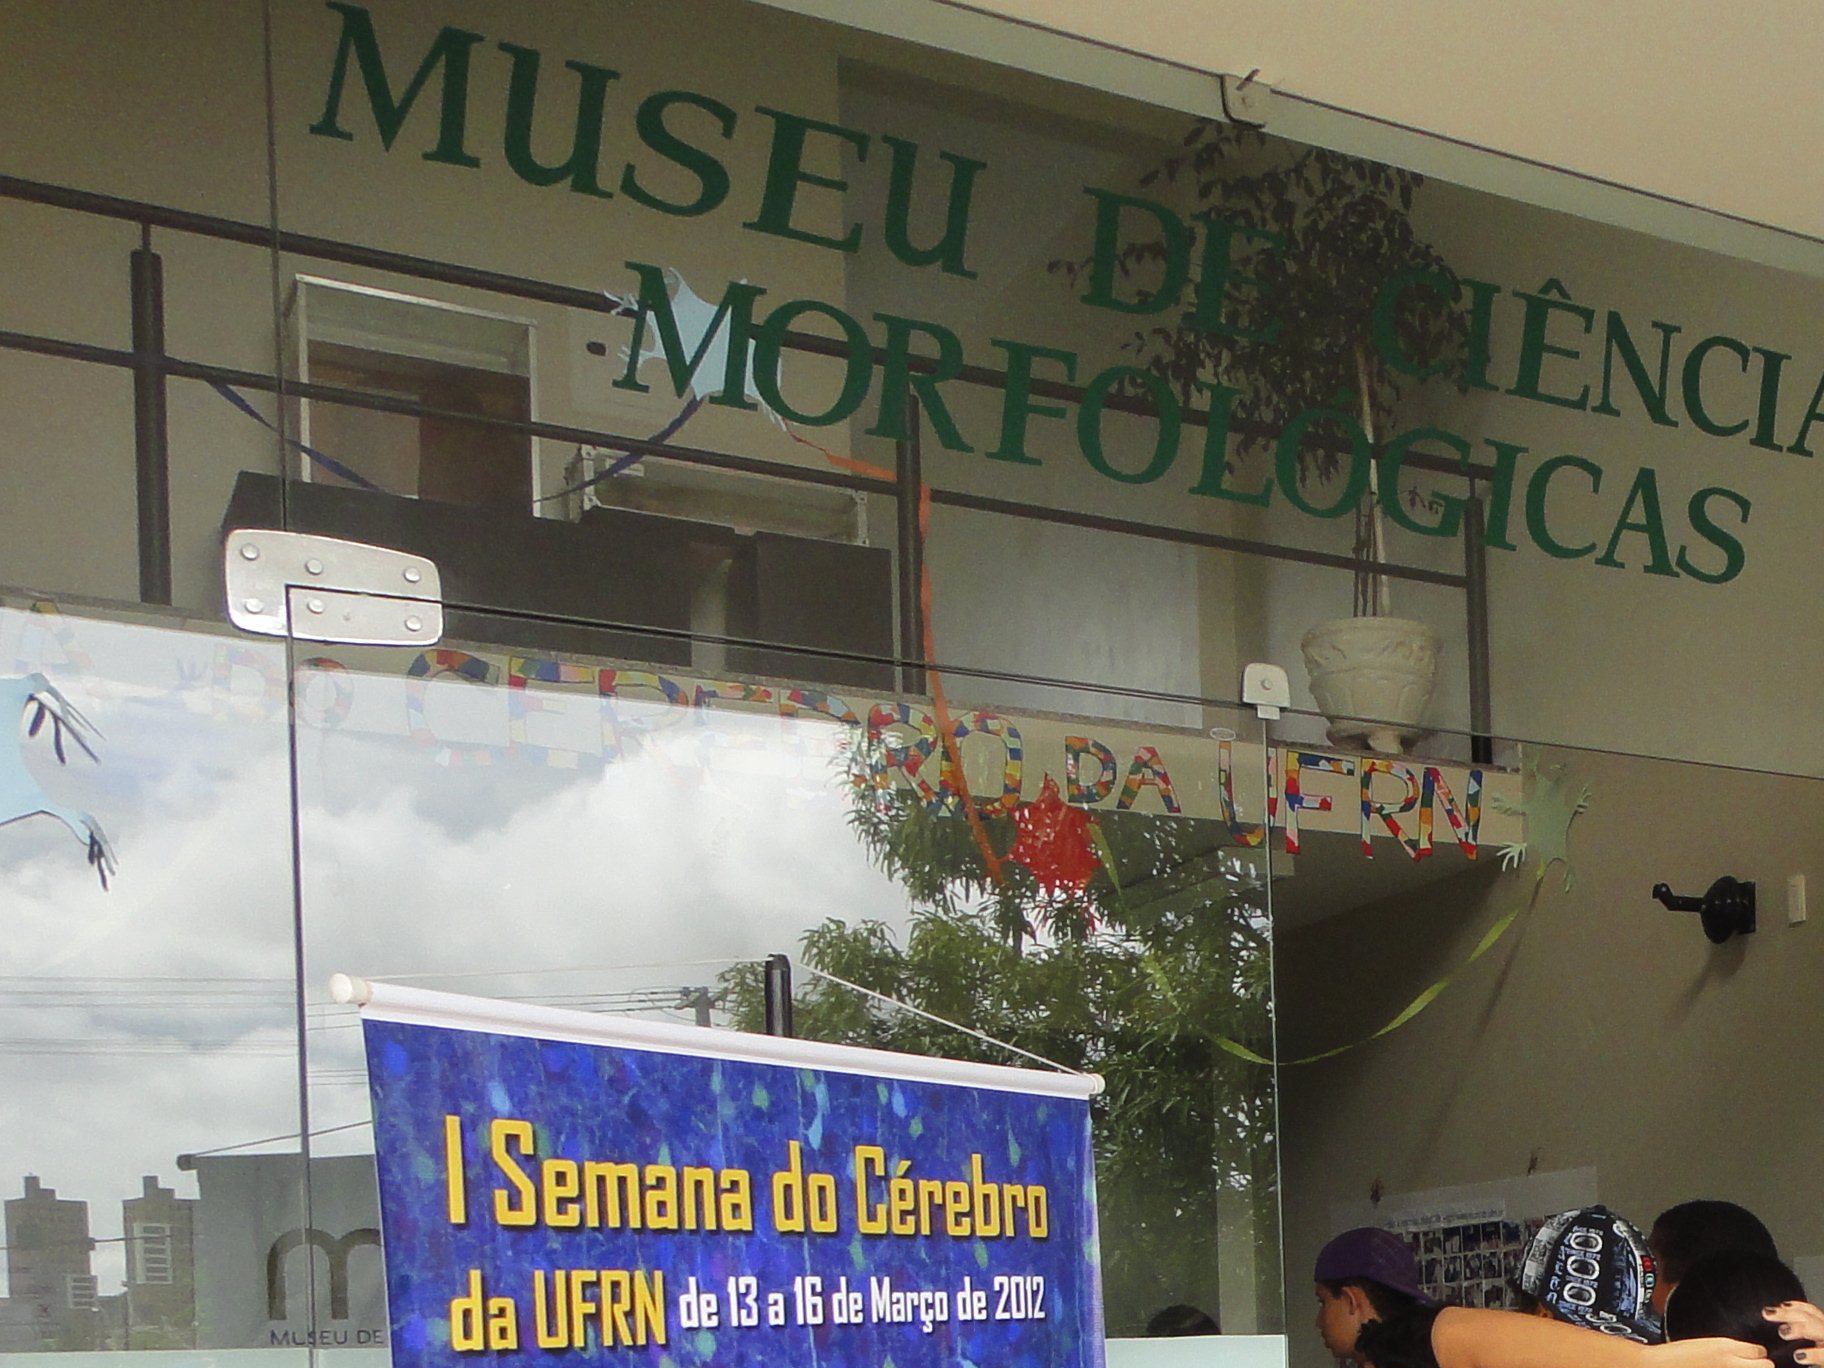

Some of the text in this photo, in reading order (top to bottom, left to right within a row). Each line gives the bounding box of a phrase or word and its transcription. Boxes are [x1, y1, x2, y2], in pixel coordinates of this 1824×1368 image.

[311, 4, 987, 279] MUSEU
[1080, 186, 1283, 343] DE
[612, 262, 1750, 584] MORFOLÓGICAS
[1064, 735, 1181, 813] DA
[1219, 741, 1482, 862] UFRN
[445, 1115, 1049, 1238] I Semana do Cérebro
[452, 1269, 1045, 1352] da UFRN de 13 a 16 de Março de 2012
